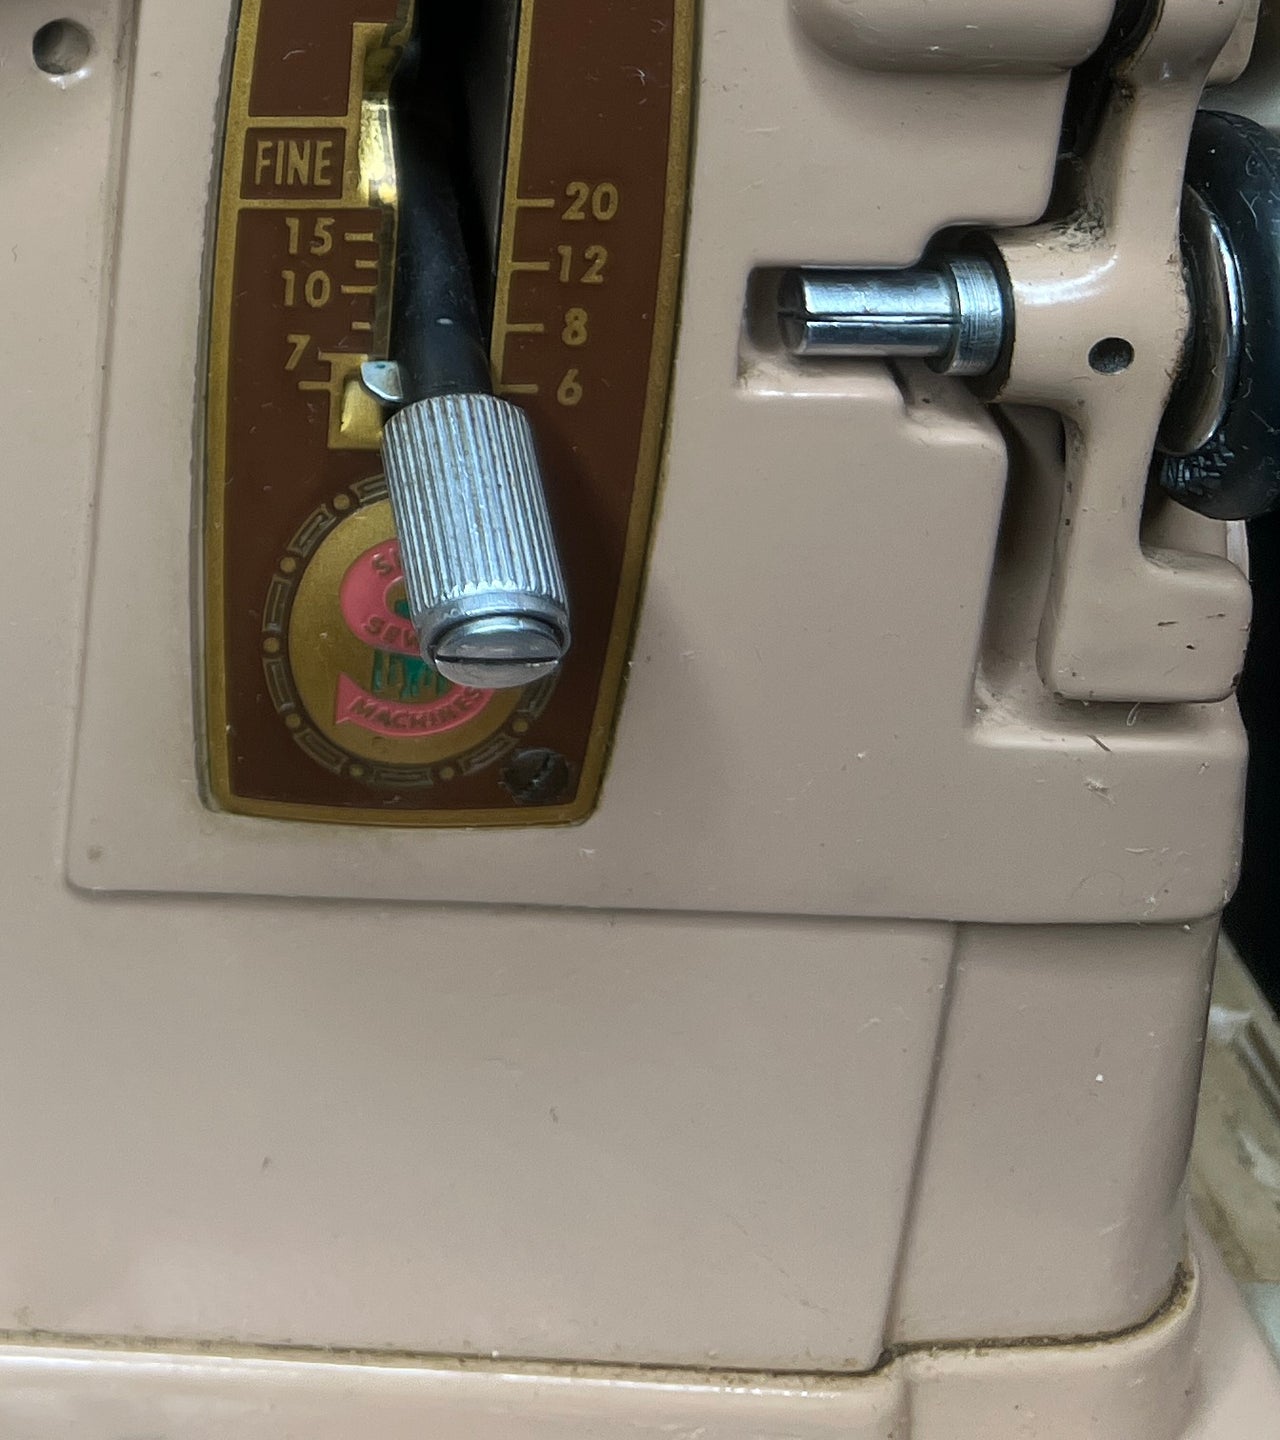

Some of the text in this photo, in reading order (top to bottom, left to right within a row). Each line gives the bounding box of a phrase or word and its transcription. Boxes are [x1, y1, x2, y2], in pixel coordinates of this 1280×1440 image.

[253, 139, 334, 188] FINE
[561, 181, 620, 222] 20
[284, 217, 334, 256] 15
[557, 245, 609, 285] 12
[280, 270, 332, 308] 10
[560, 308, 590, 346] 8
[285, 334, 312, 372] 7
[556, 368, 583, 406] 6
